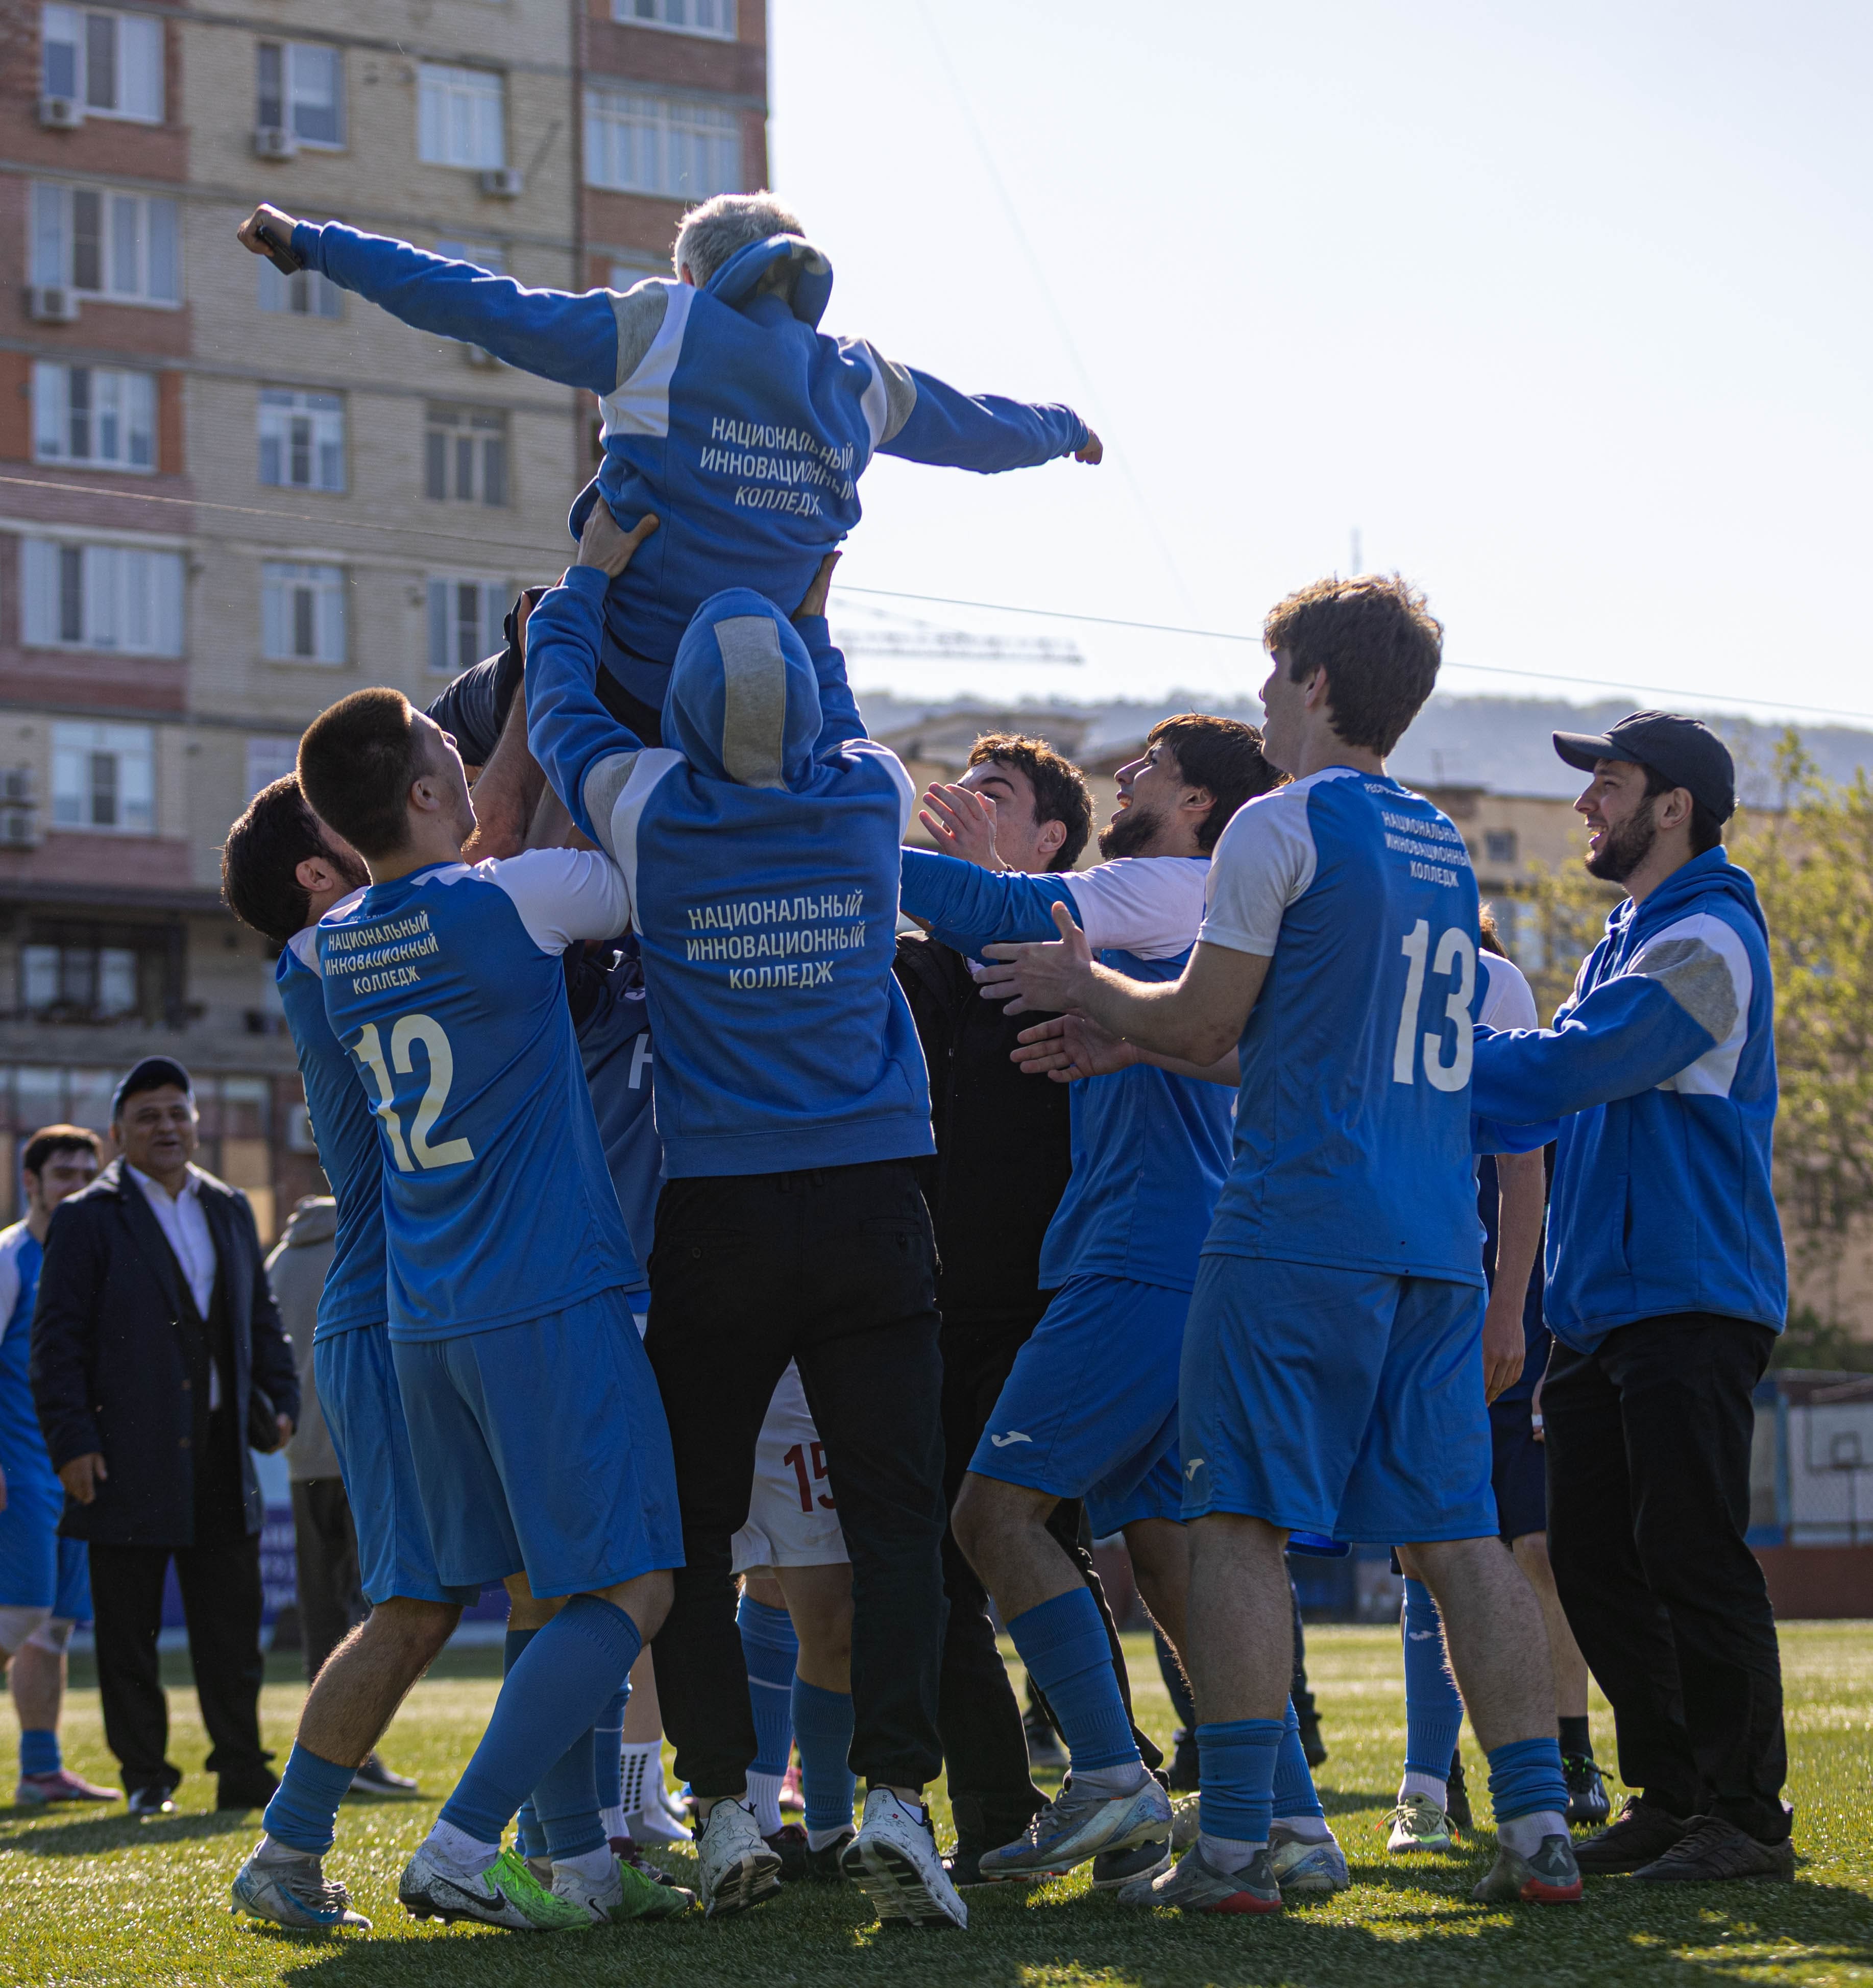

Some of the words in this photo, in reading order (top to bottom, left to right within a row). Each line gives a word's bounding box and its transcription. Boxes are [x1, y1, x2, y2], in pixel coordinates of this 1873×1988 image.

[711, 417, 854, 471] НАЦИОНАЛЬНЫЙ
[735, 486, 823, 517] КОЛЛЕДЖ
[1381, 811, 1464, 843] НАЦИОНАЛЬНЫ
[1384, 832, 1471, 868] ИННОВАЦИОННЫ
[1410, 860, 1460, 888] КОЛЛЕДЖ
[688, 889, 864, 931] НАЦИОНАЛЬНЫЙ
[328, 910, 429, 952] НАЦИОНАЛЬНЫЙ
[686, 920, 866, 961] ИННОВАЦИОННЫЙ
[325, 932, 440, 976] ИННОВАЦИОННЫЙ
[353, 965, 421, 995] КОЛЛЕДЖ
[729, 961, 834, 989] КОЛЛЕДЖ
[1393, 918, 1476, 1092] 13
[352, 1014, 475, 1172] 12
[784, 1441, 837, 1512] 15
